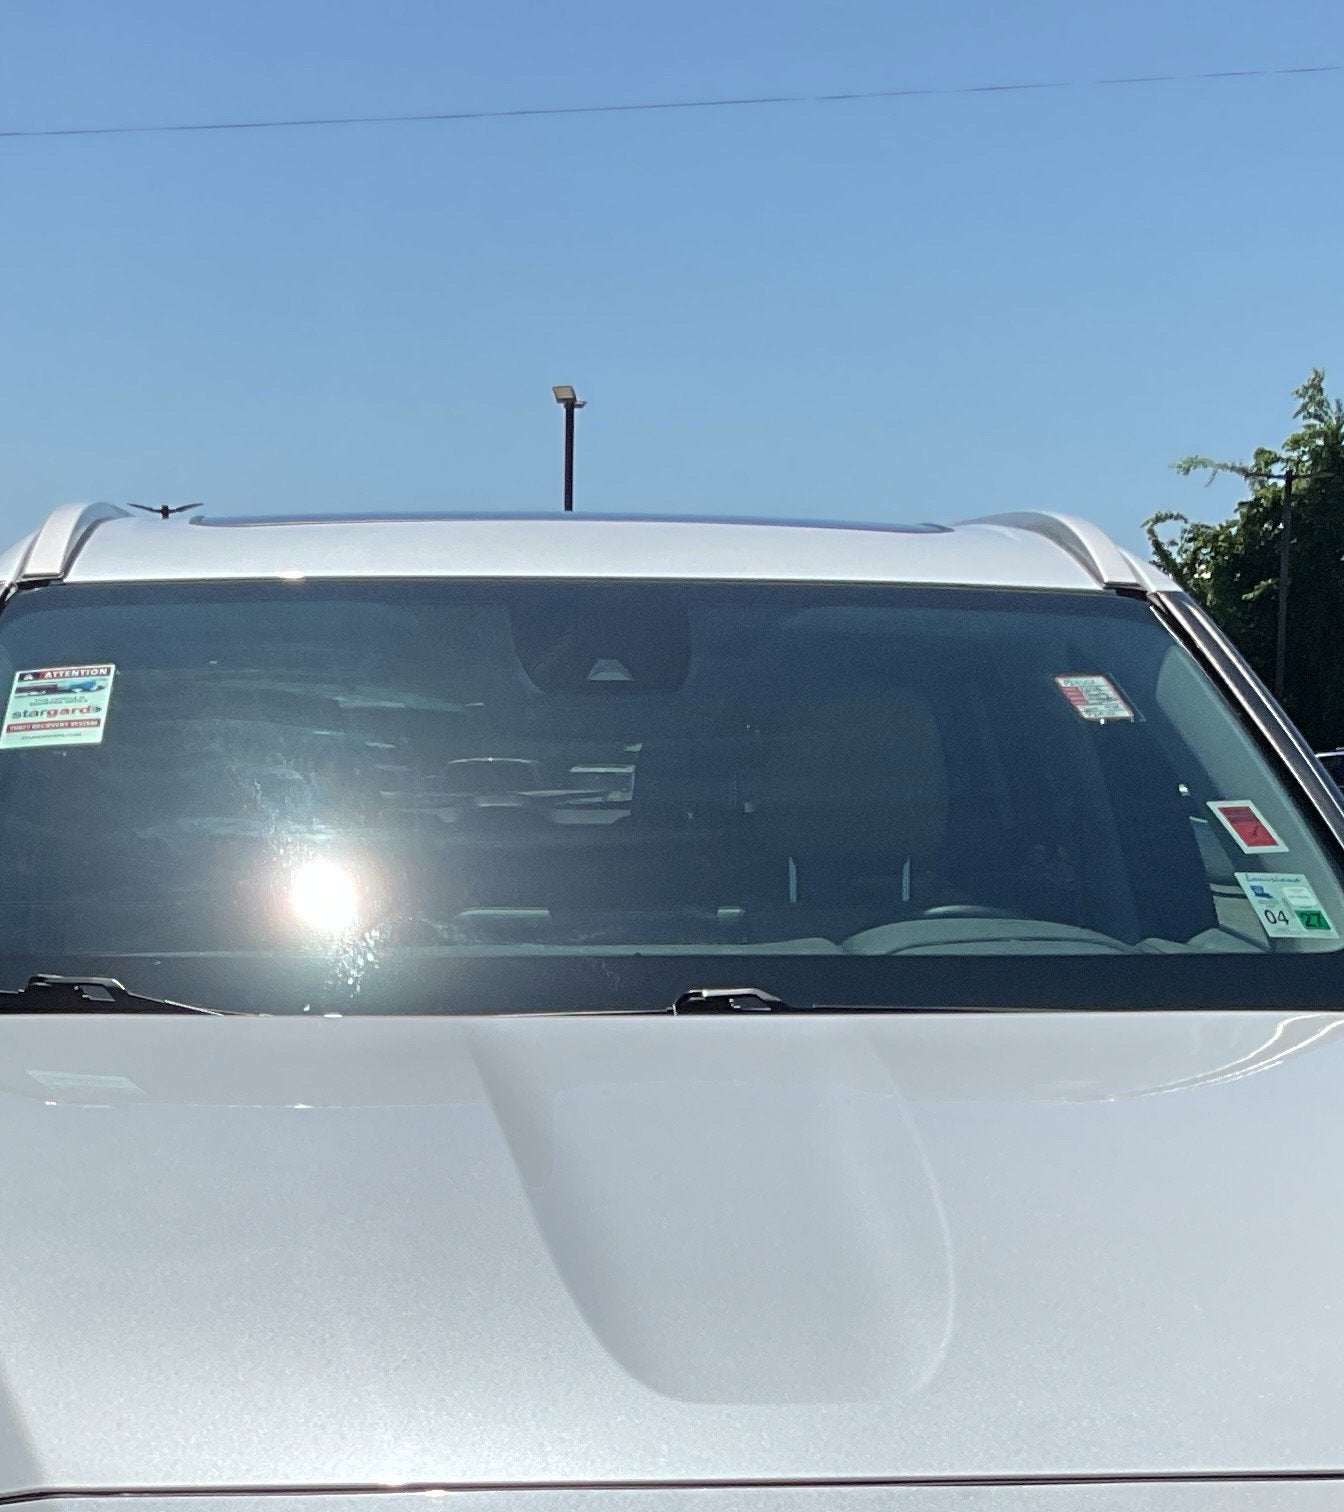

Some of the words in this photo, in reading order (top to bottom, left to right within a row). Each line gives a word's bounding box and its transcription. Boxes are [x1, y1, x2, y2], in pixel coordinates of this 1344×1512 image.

[44, 669, 108, 679] ATTENTION
[12, 706, 90, 718] stargard
[1264, 909, 1289, 925] 04
[1302, 911, 1322, 927] 27
